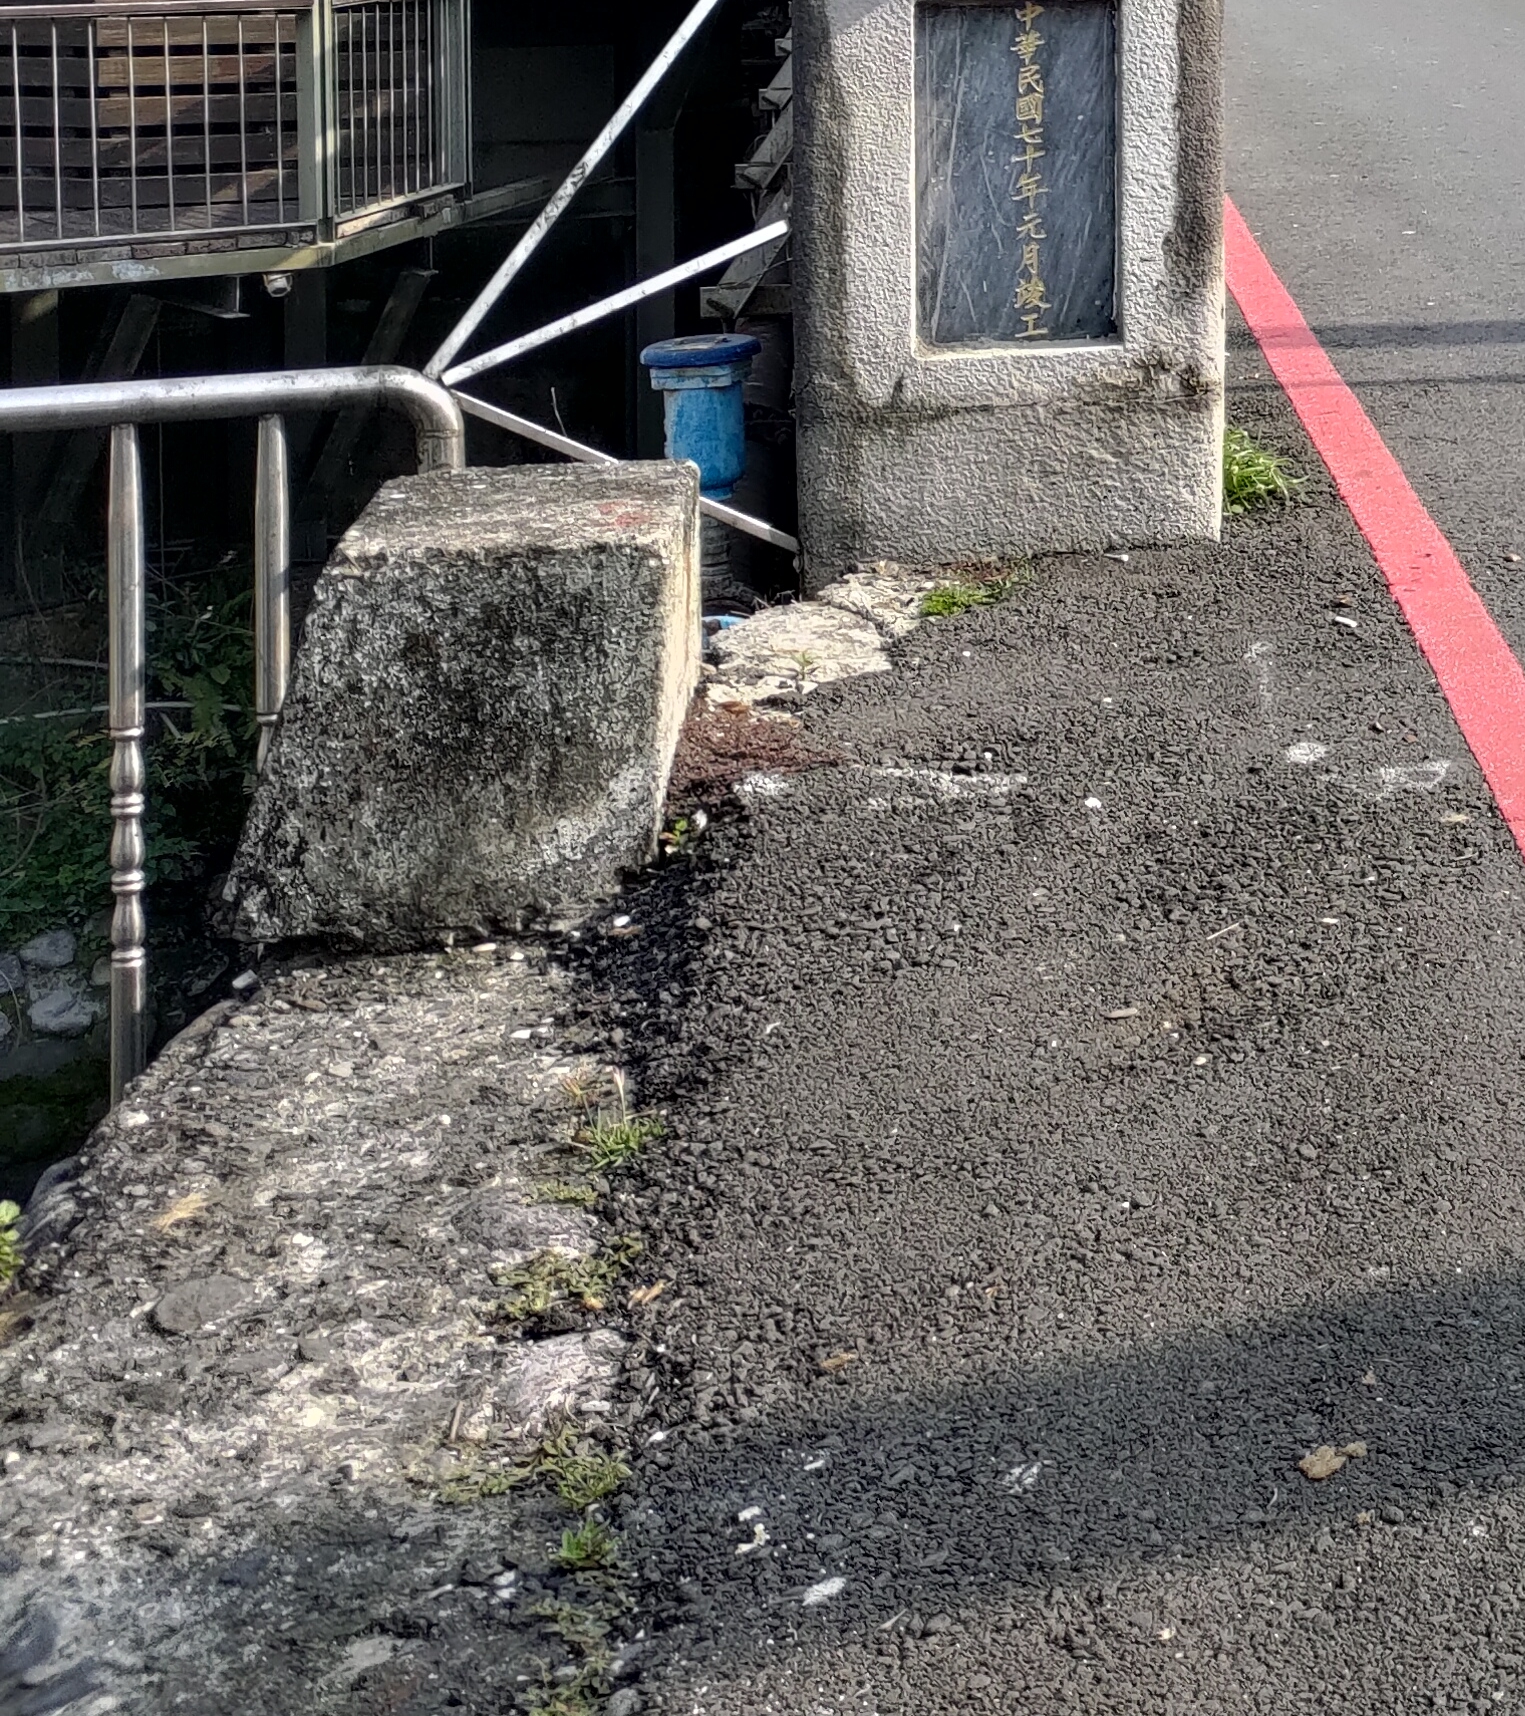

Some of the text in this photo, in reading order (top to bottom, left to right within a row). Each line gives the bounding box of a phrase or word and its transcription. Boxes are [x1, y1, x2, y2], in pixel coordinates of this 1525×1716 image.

[1010, 1, 1052, 338] 中華民國七十年元月竣工
